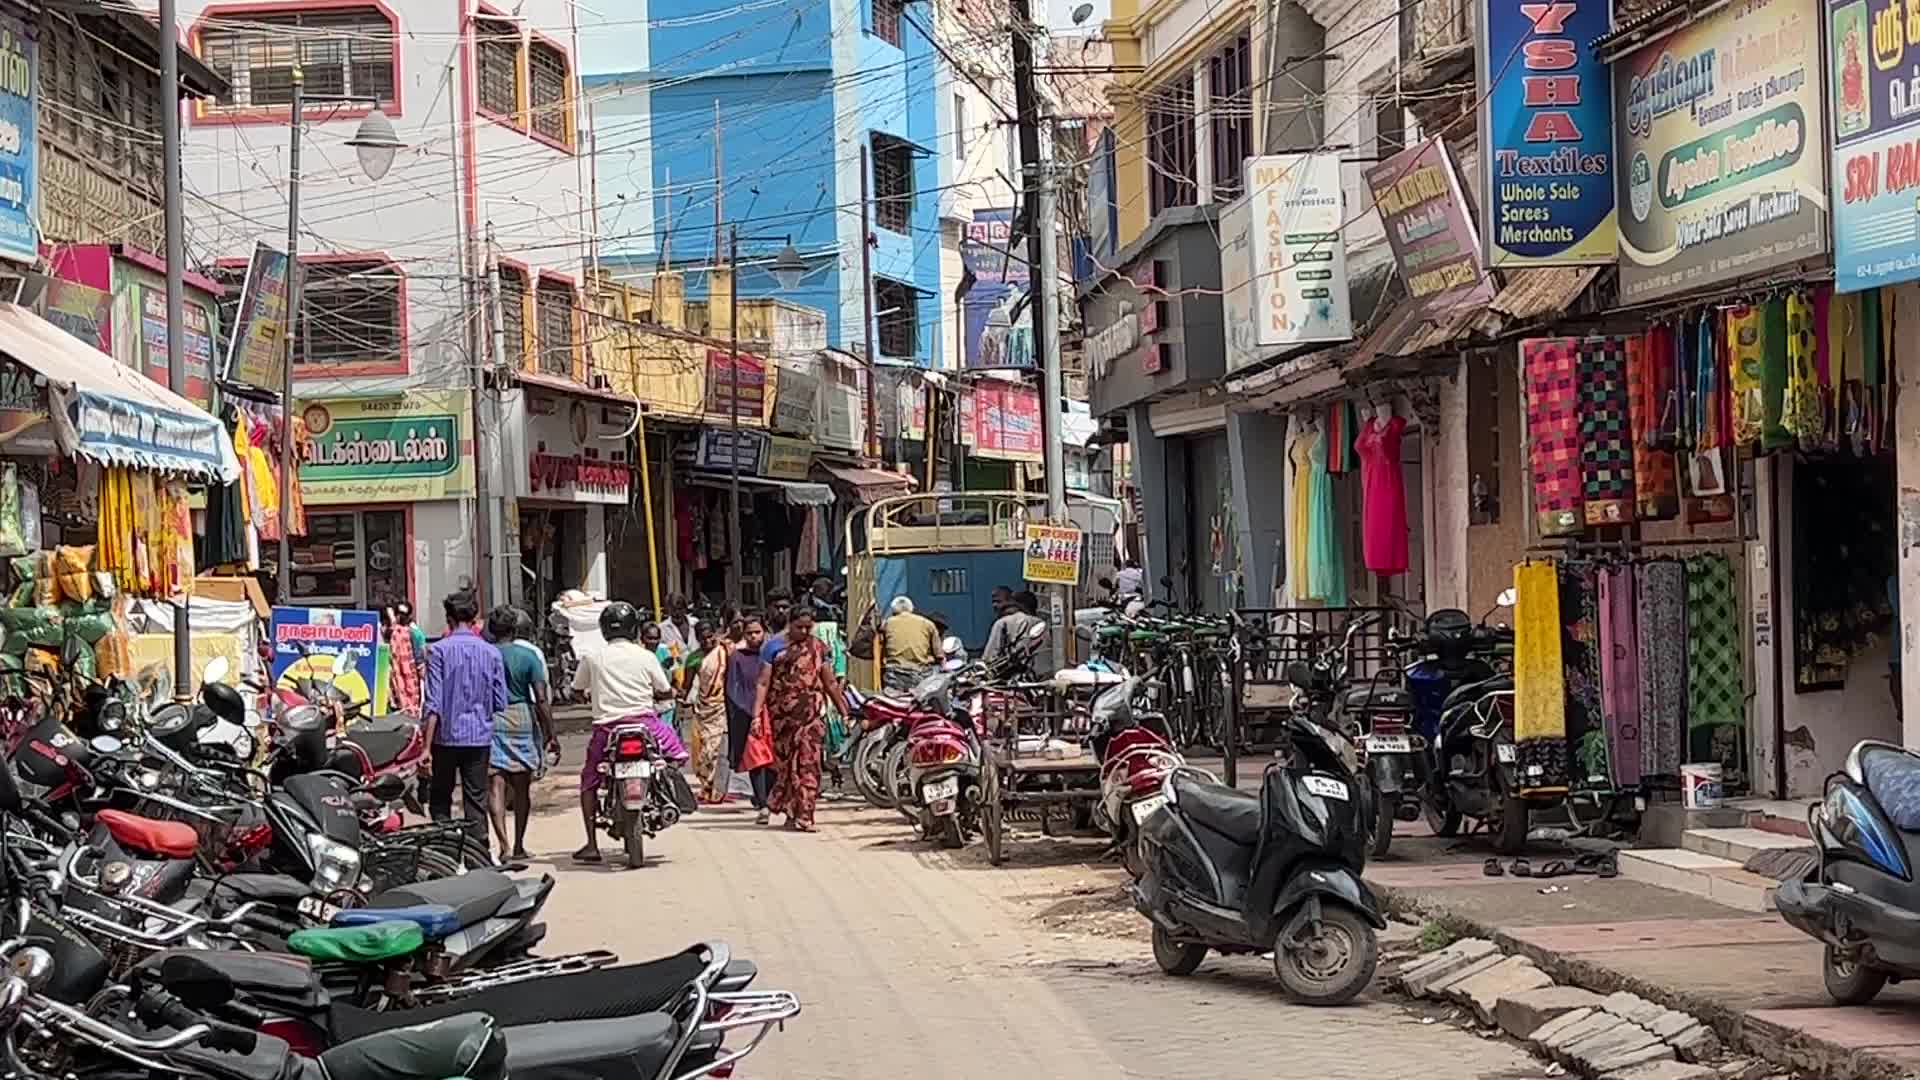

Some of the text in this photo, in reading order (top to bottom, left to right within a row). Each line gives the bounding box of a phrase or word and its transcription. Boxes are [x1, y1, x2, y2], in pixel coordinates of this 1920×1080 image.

[1628, 48, 1716, 137] ஆயிஷா
[1723, 118, 1800, 176] Textiles
[1496, 147, 1608, 177] Textiles
[1844, 151, 1879, 204] SRI
[1501, 181, 1581, 202] Whole Sale
[1501, 204, 1550, 223] Sarees
[1501, 224, 1574, 245] Merchants
[1265, 190, 1288, 331] FASHION
[1047, 548, 1078, 562] FREE
[276, 623, 374, 642] ராஜாமணி
